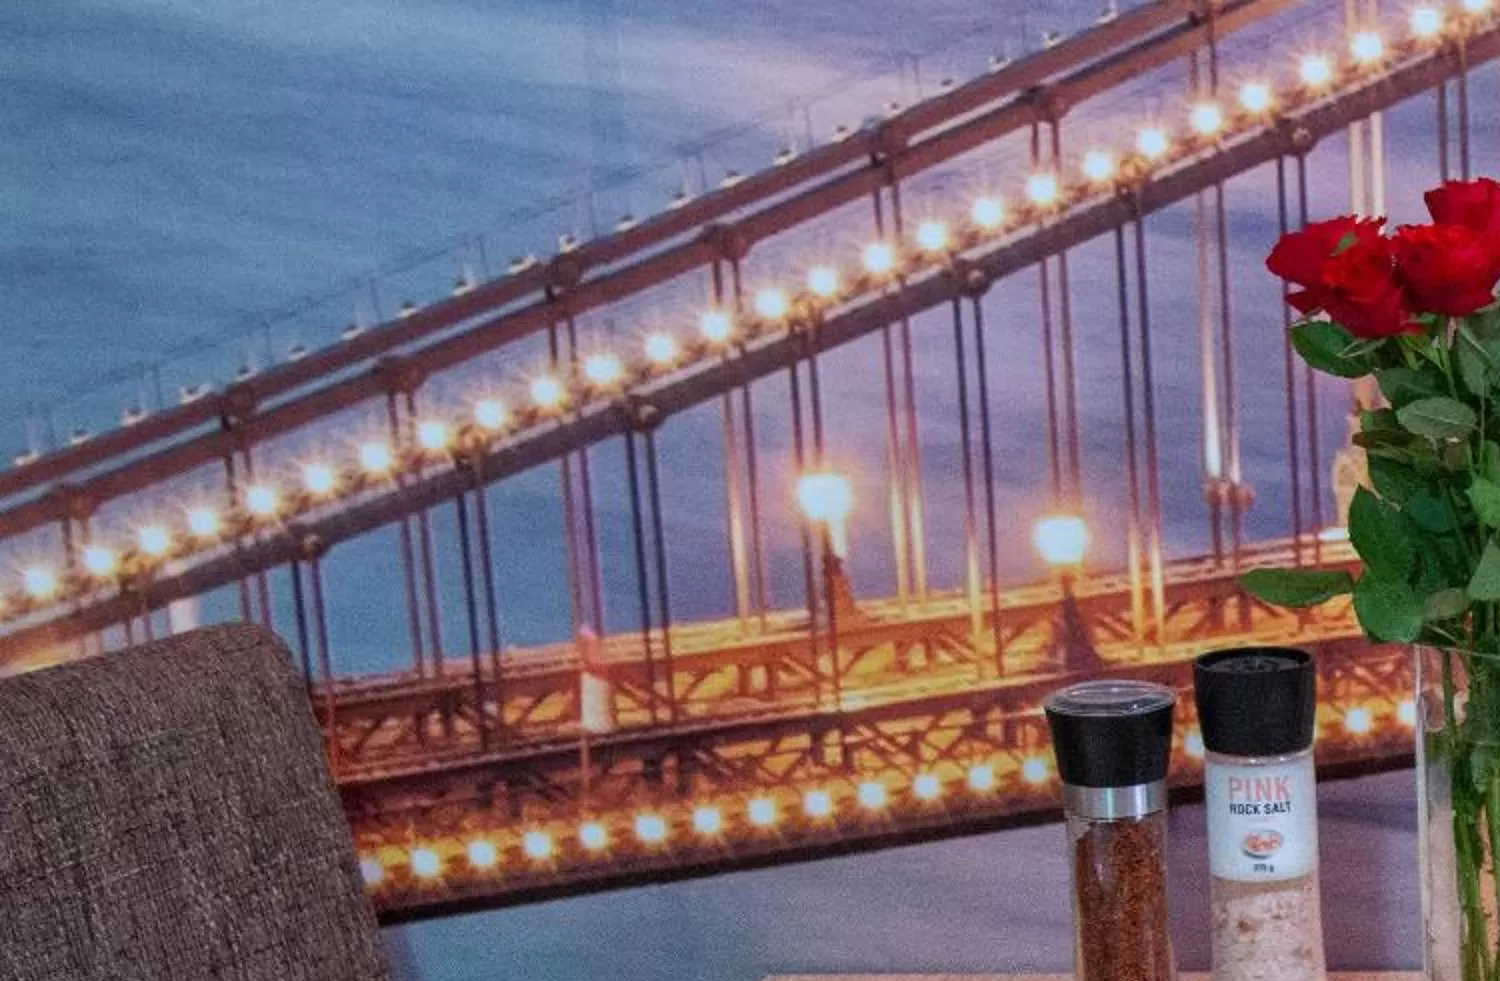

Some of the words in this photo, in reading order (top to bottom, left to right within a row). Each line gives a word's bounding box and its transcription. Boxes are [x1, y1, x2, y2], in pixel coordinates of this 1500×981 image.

[1228, 775, 1293, 802] PINK
[1229, 803, 1261, 815] ROCK
[1263, 801, 1292, 815] SALT
